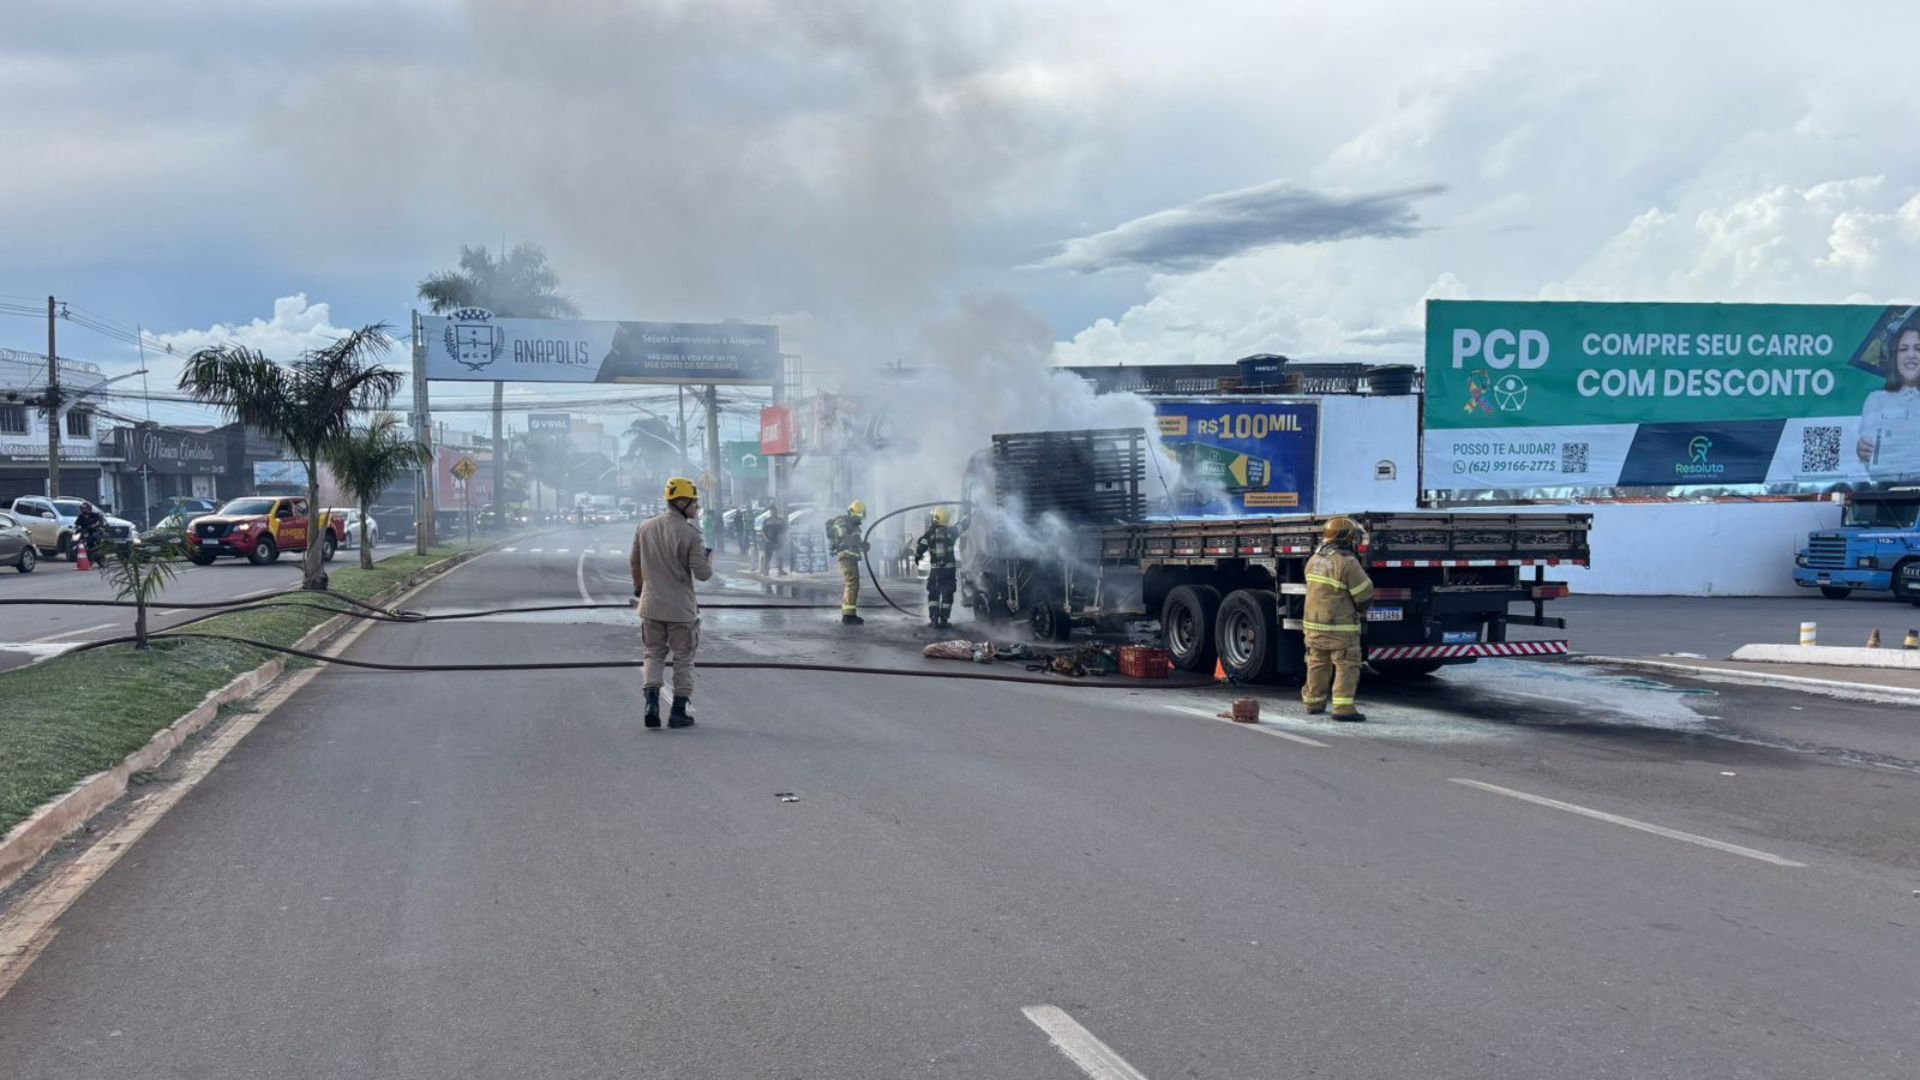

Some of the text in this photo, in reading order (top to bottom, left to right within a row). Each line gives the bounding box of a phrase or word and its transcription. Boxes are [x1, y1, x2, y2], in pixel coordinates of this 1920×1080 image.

[514, 337, 589, 364] ANÁPOLIS
[1452, 328, 1549, 370] PCD
[1582, 333, 1833, 356] COMPRE SEU CARRO
[1577, 368, 1835, 397] COM DESCONTO
[1453, 442, 1556, 455] POSSO TE AJUDAR?
[1468, 460, 1556, 474] (62) 99166-2775
[1675, 463, 1724, 474] Resoluta
